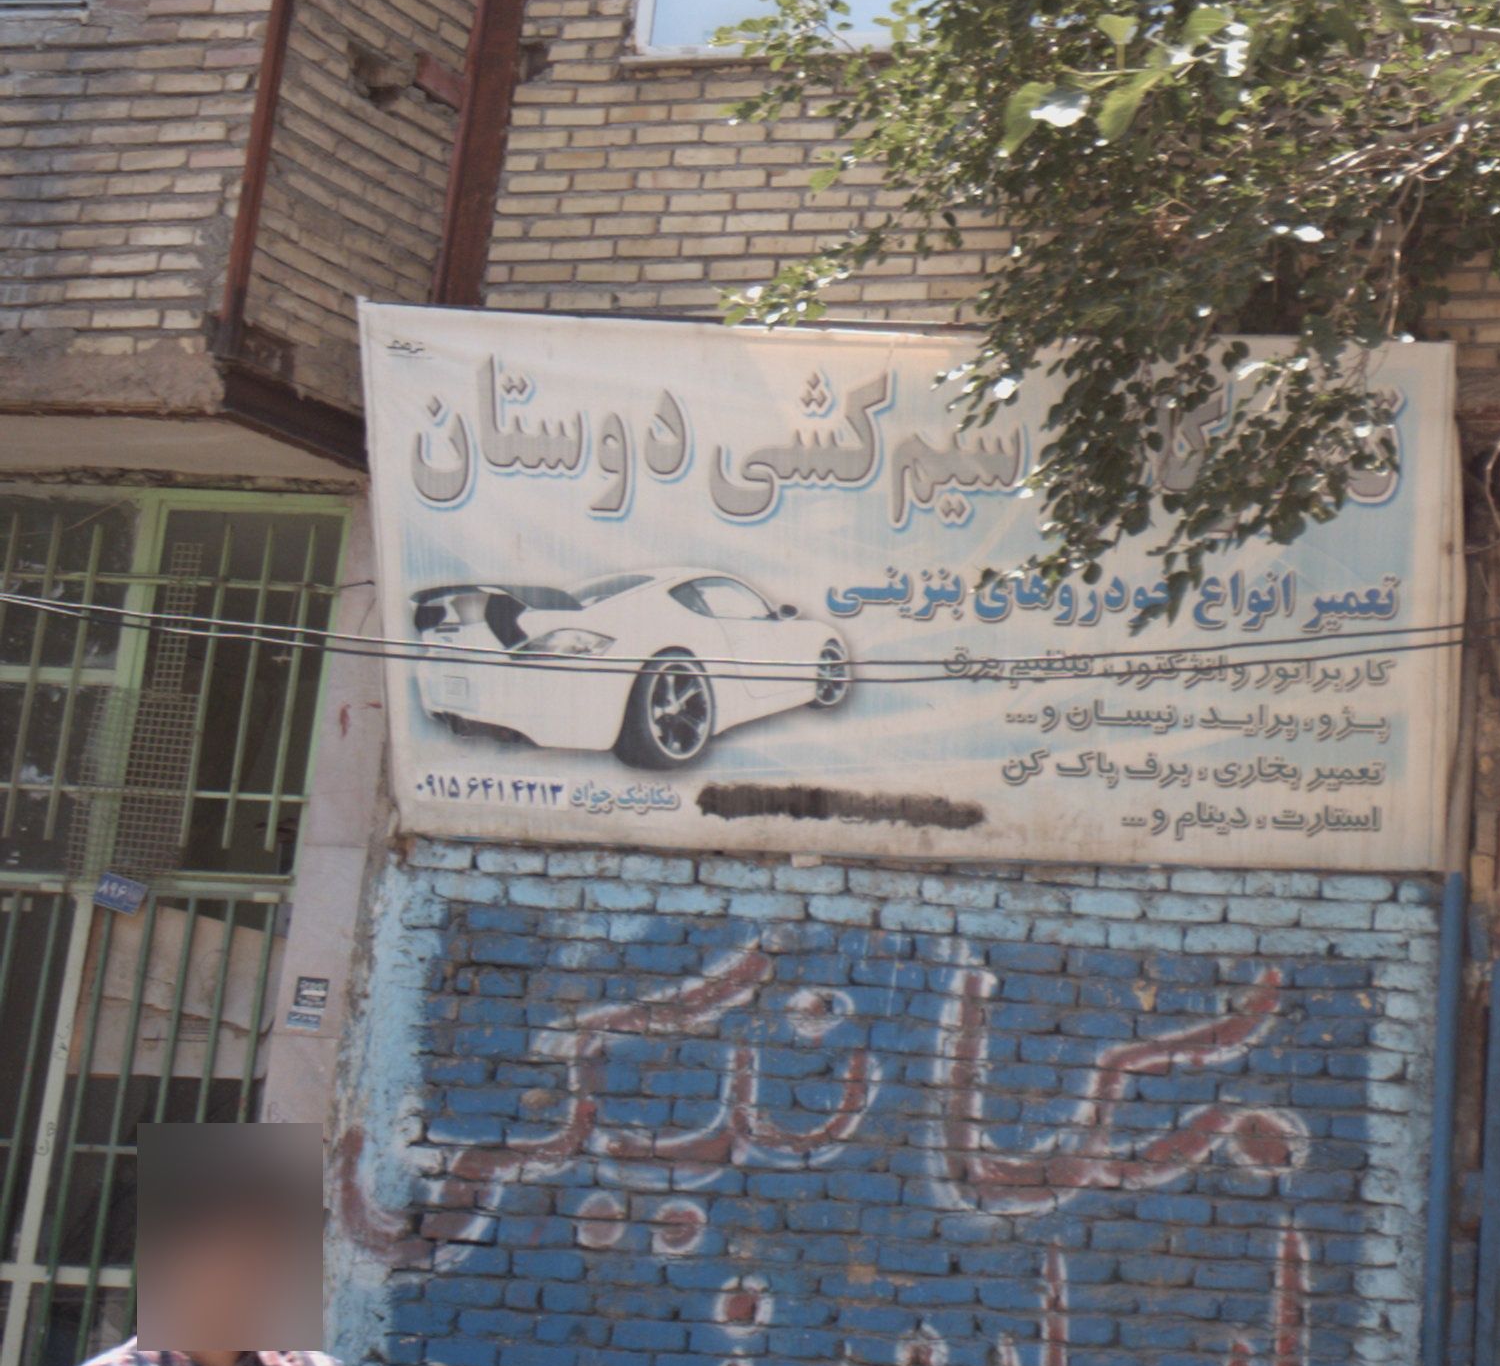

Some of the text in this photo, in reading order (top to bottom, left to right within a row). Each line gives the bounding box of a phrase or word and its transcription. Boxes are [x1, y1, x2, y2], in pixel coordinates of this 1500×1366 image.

[410, 353, 692, 522] دوستان
[709, 372, 896, 525] کشی
[890, 424, 1030, 531] سیم
[825, 566, 966, 620] بنزینی
[1191, 568, 1297, 629] انواع
[1301, 573, 1401, 633] تعمیر
[1253, 659, 1397, 694] کاربراتور
[1065, 699, 1178, 733] نیسان
[1124, 751, 1194, 787] برف
[1306, 761, 1387, 792] تعمیر
[1174, 801, 1250, 841] دینام
[338, 930, 1308, 1269] مکانیکی
